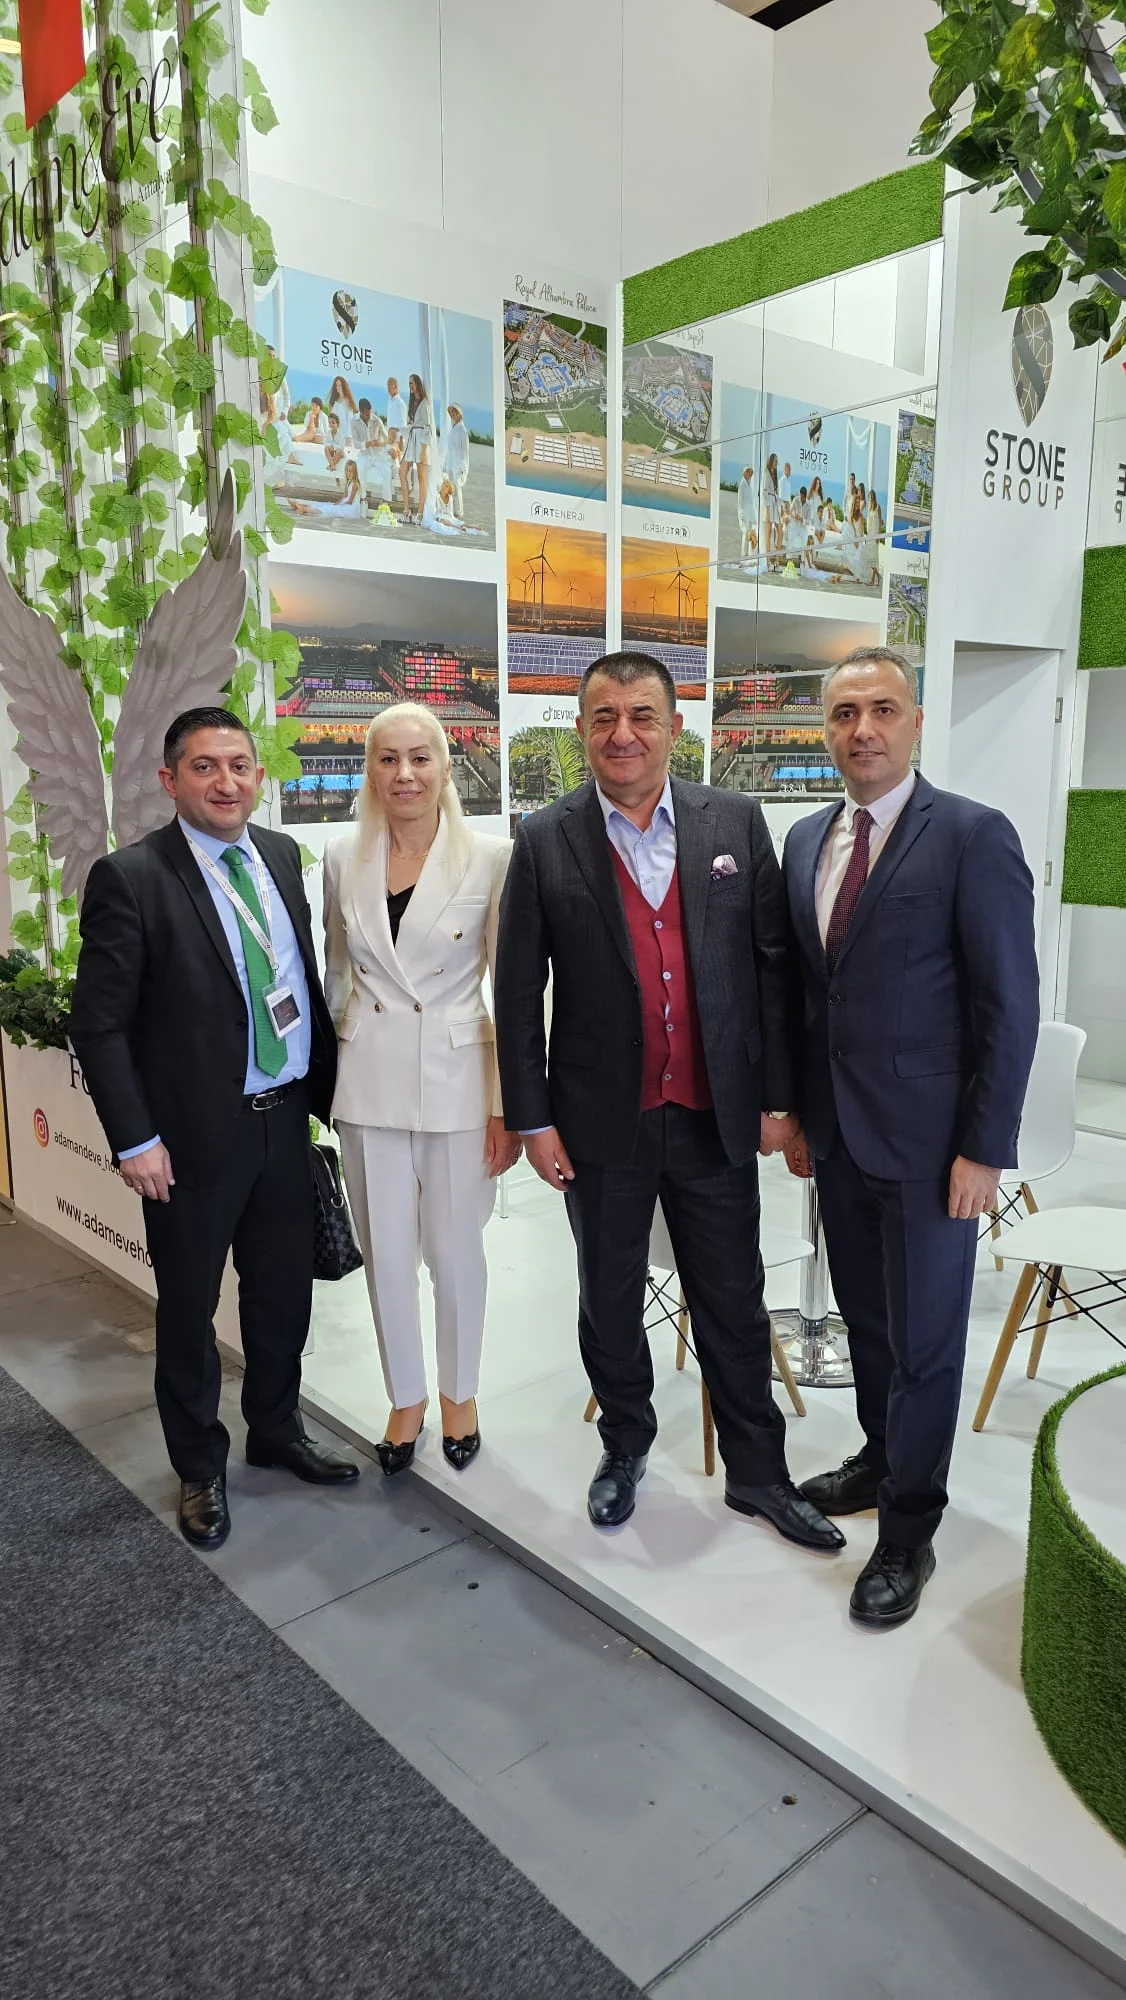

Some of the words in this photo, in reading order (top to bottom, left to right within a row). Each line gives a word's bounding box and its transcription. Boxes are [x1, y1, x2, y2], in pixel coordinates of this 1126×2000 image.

[515, 274, 537, 302] Royal
[540, 282, 574, 306] Alhambra
[576, 292, 598, 313] Palace
[321, 339, 373, 365] STONE
[321, 355, 373, 376] GROUP
[984, 429, 1066, 482] STONE
[983, 470, 1064, 510] GROUP
